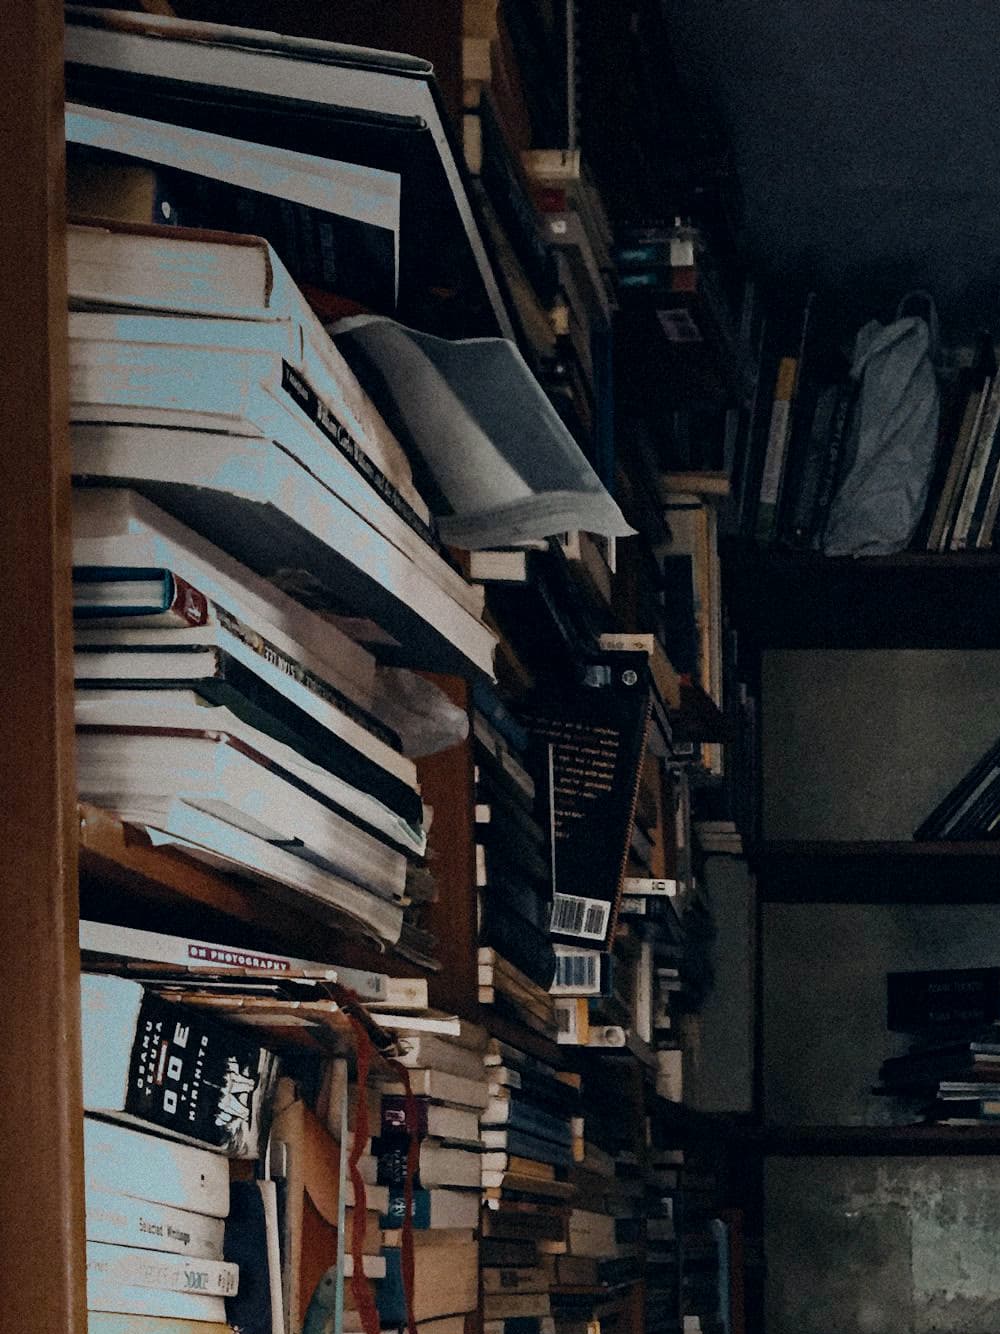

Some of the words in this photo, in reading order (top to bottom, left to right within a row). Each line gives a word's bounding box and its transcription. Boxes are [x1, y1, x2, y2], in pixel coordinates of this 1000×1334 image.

[189, 946, 207, 957] ON
[210, 950, 287, 970] PHOTOGRAPHY
[137, 1020, 153, 1089] OSAMU
[145, 1021, 163, 1097] TEZUKA
[188, 1035, 209, 1121] KIRIHITO
[181, 1083, 189, 1101] TO
